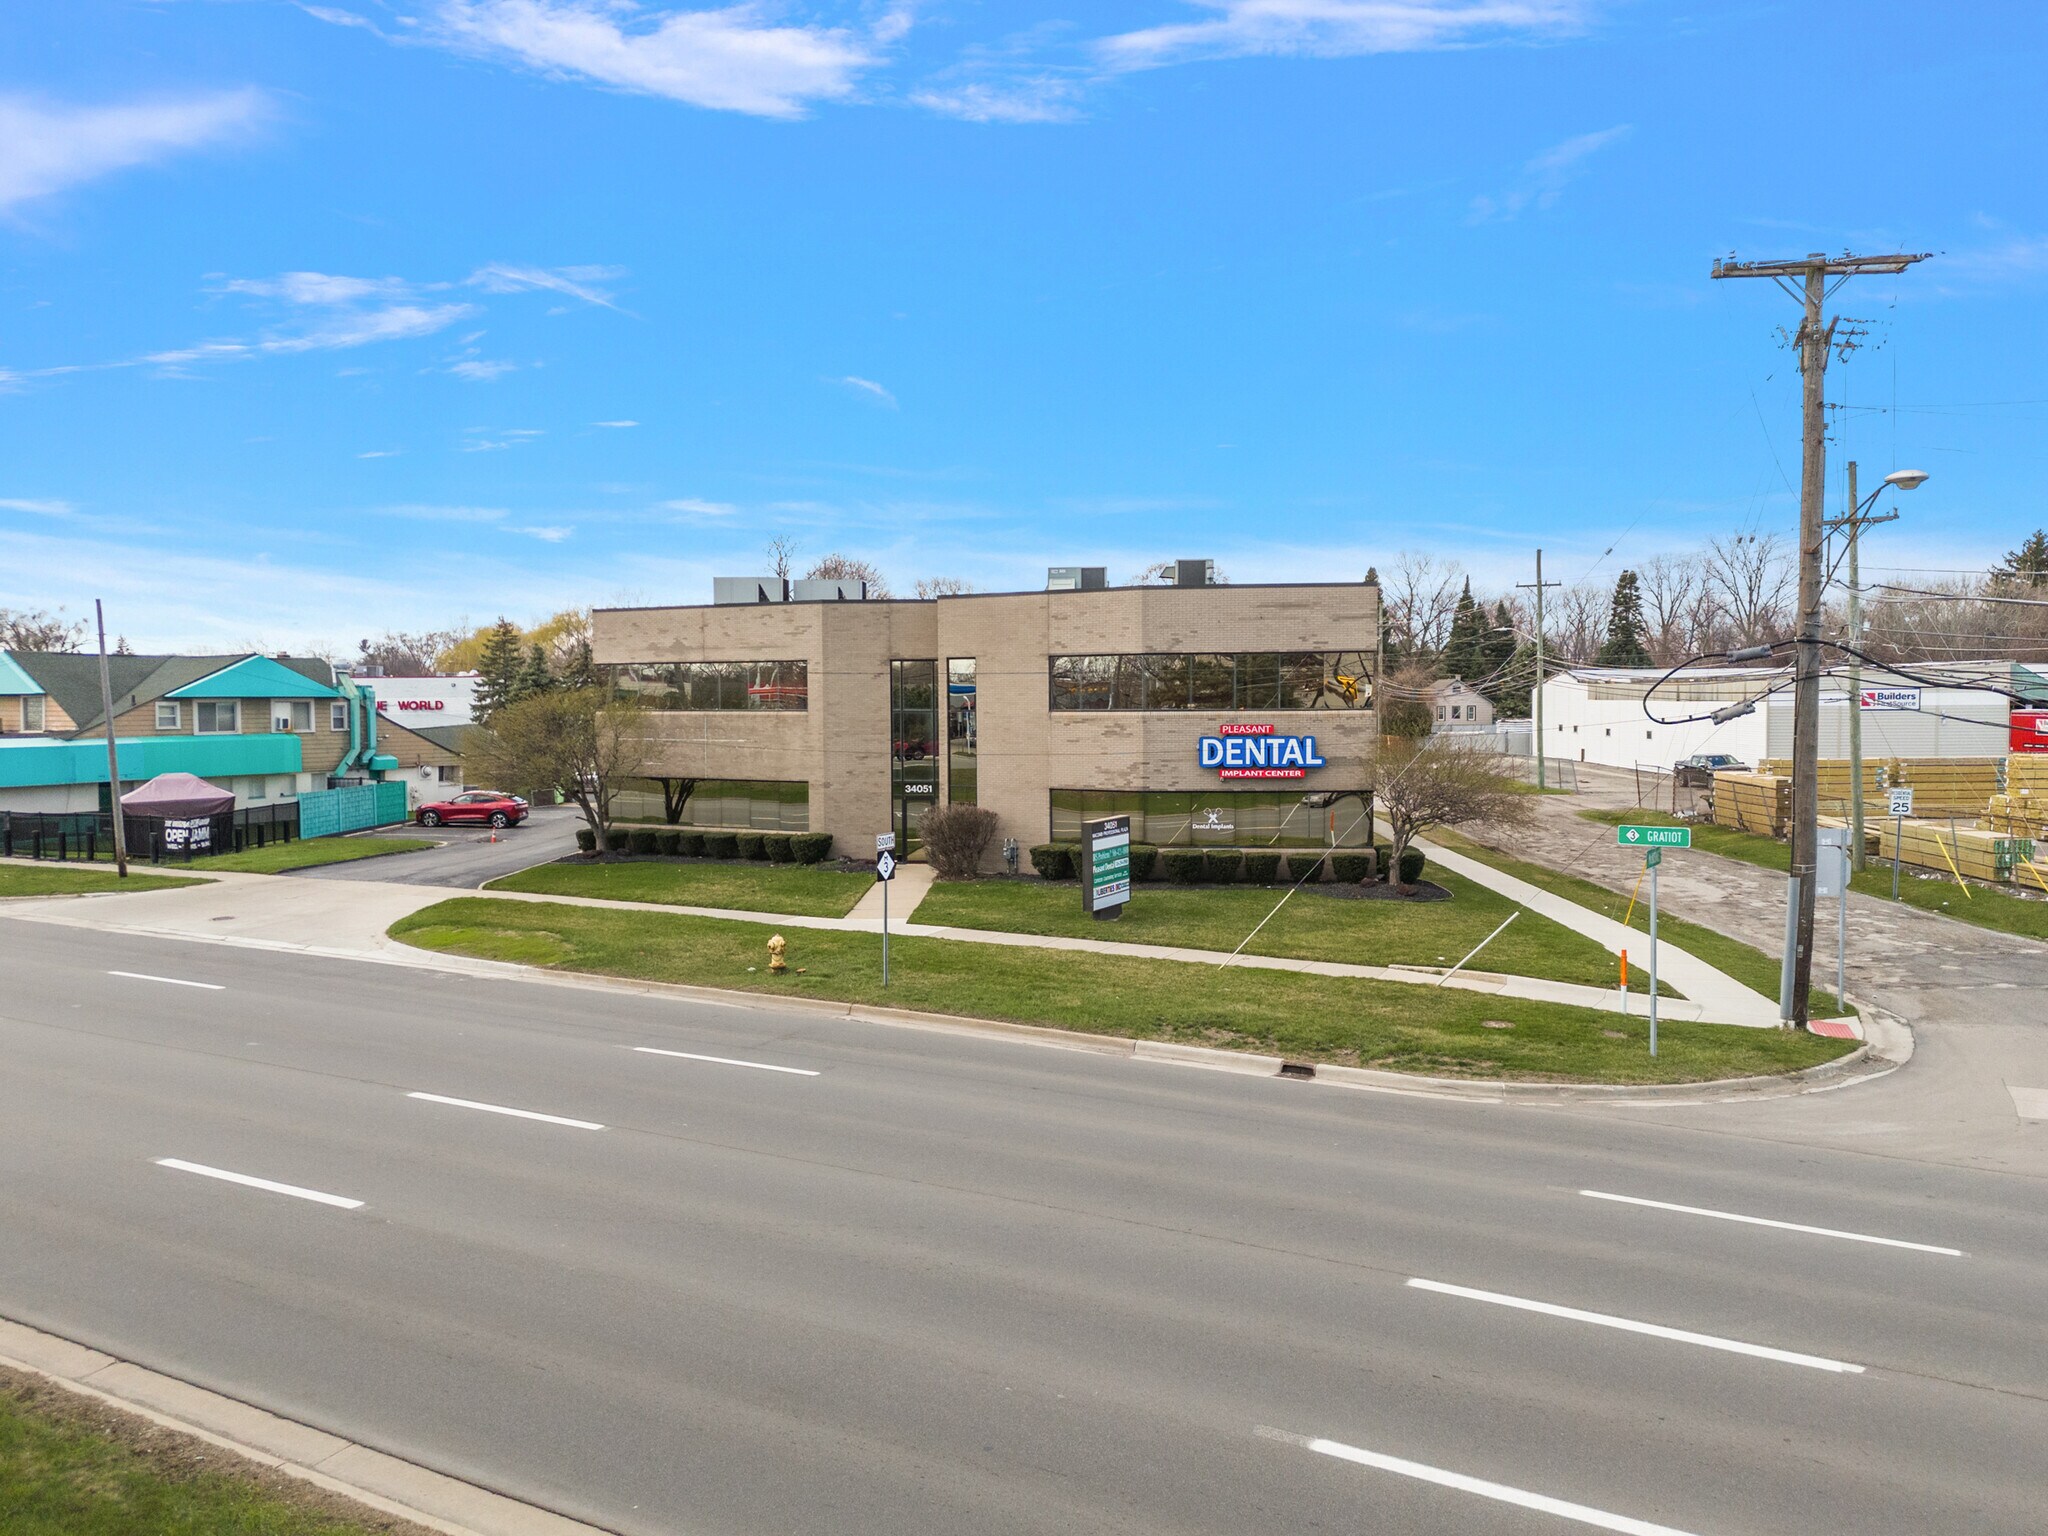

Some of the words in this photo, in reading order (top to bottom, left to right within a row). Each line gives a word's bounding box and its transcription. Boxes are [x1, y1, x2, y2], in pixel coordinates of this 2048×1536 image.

[1877, 692, 1916, 700] Builders
[398, 701, 444, 710] WORLD
[1222, 725, 1271, 734] PLEASANT
[1202, 738, 1323, 765] DENTAL
[904, 784, 933, 793] 34051
[1892, 802, 1910, 812] 25
[878, 836, 894, 846] SOUTH
[1630, 830, 1636, 840] 3
[1647, 830, 1683, 843] GRATIOT
[883, 861, 889, 873] 3
